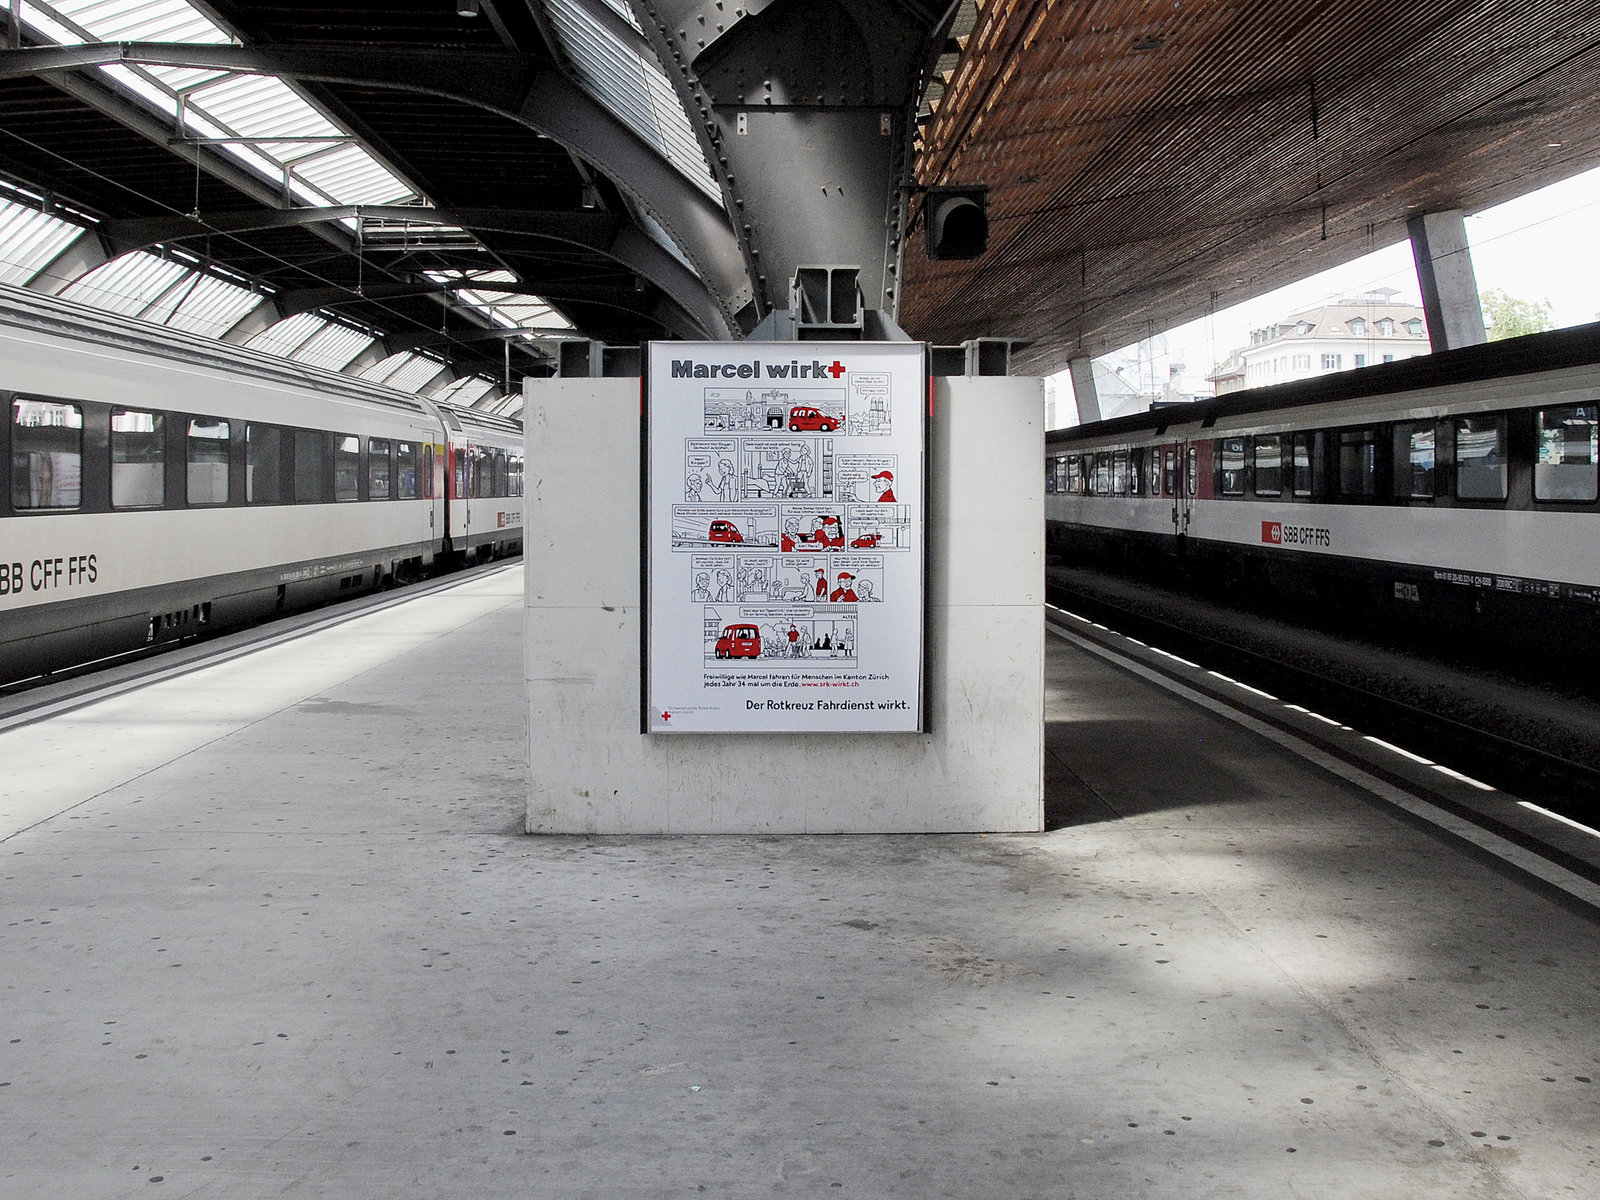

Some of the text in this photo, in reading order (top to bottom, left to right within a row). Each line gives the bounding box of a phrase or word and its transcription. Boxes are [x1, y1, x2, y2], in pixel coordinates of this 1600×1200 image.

[671, 360, 760, 379] Marcel
[1283, 526, 1331, 547] SBB CFF FFS
[30, 558, 63, 591] CFF
[69, 554, 98, 585] FFS
[703, 673, 735, 682] Freiwillige
[747, 673, 768, 681] Marcel
[769, 673, 790, 681] fahren
[791, 673, 801, 681] für
[801, 673, 833, 681] Menschen
[843, 673, 867, 681] Kanton
[868, 673, 890, 681] Zürich
[703, 680, 721, 689] jedes
[722, 680, 737, 688] Jahr
[737, 680, 746, 688] 34
[747, 680, 760, 688] mal
[771, 680, 783, 688] die
[783, 680, 801, 688] Erde.
[801, 680, 860, 688] www.srk-wirkt.ch
[746, 699, 911, 710] Der Rotkreuz Fahrdienst wirkt.
